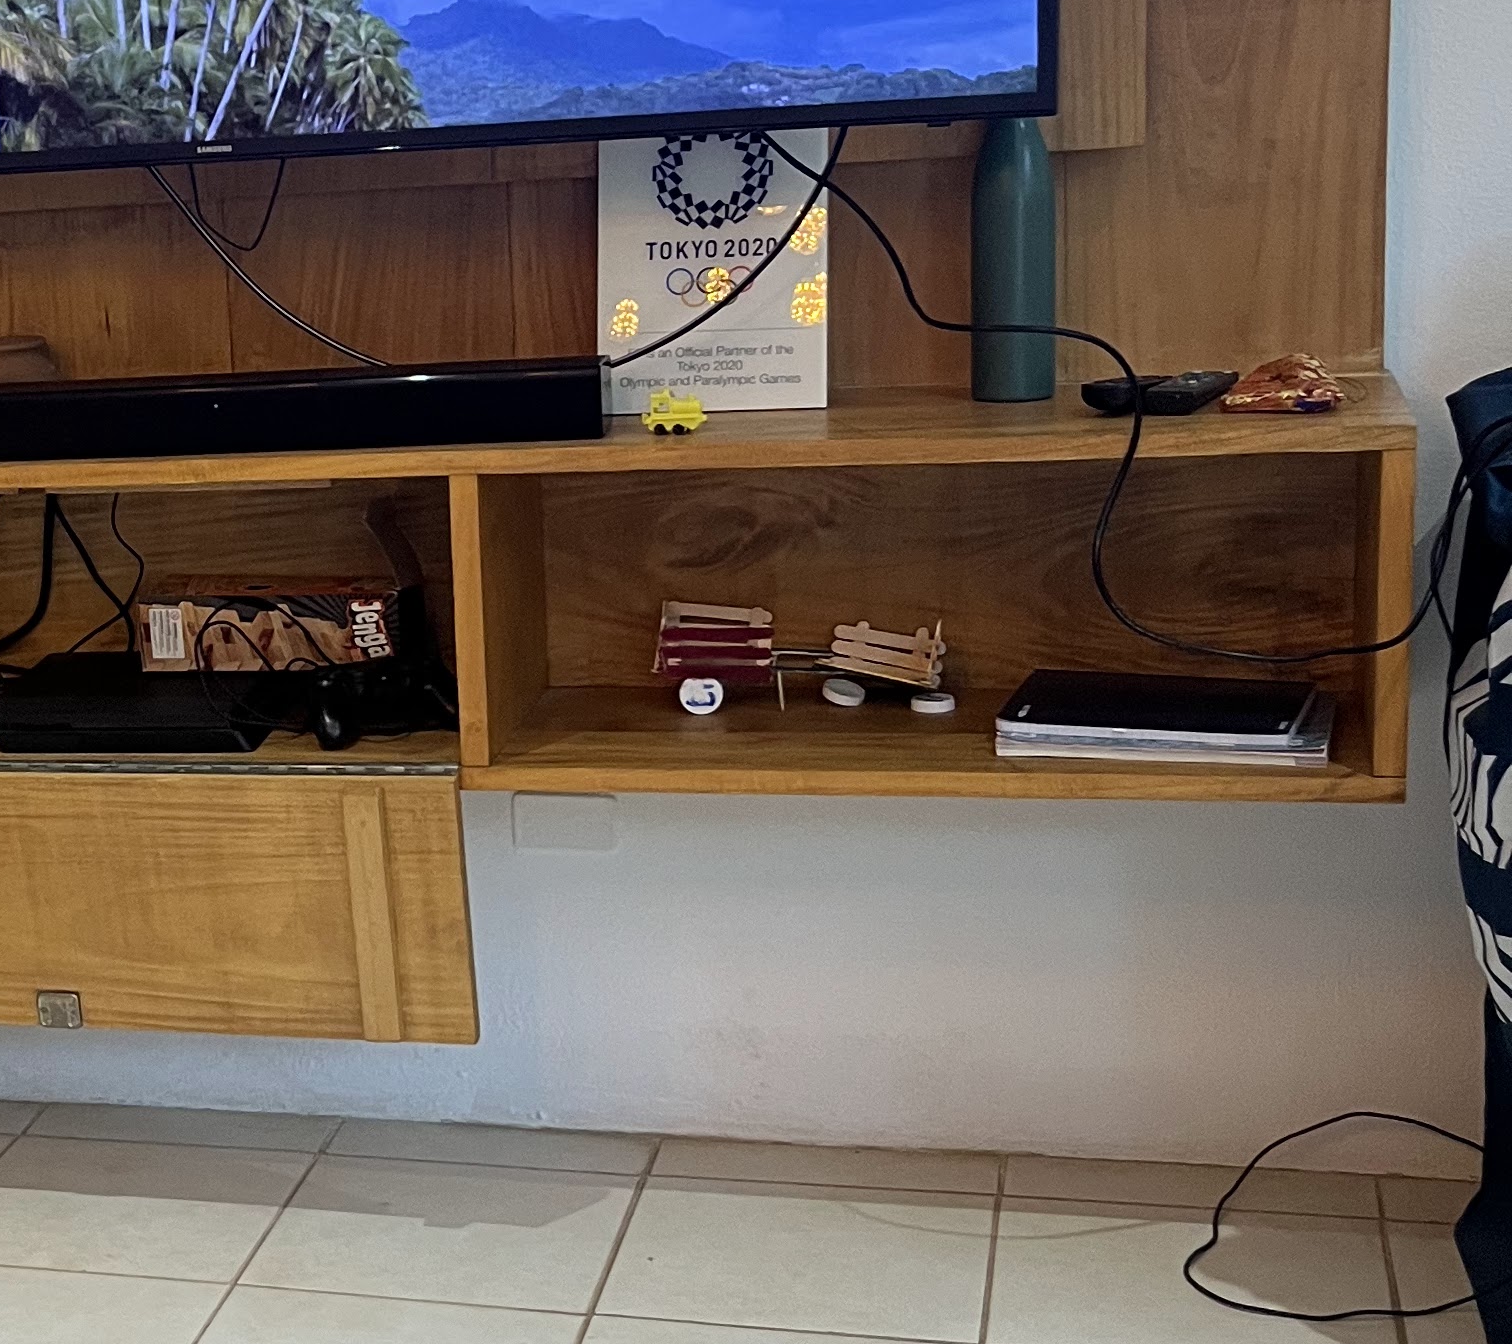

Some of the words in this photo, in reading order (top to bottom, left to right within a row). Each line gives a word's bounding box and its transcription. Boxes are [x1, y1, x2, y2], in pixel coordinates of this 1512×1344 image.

[645, 239, 718, 261] TOKYO
[657, 348, 672, 358] an
[675, 346, 713, 358] Official
[716, 344, 758, 356] Partner
[761, 344, 773, 355] of
[775, 344, 795, 355] the
[677, 361, 711, 373] Tokyo
[713, 359, 744, 371] 2020
[619, 376, 665, 389] Olympic
[669, 375, 691, 387] and
[693, 374, 757, 388] Paralympic
[759, 372, 802, 385] Games
[350, 600, 392, 659] Jenga
